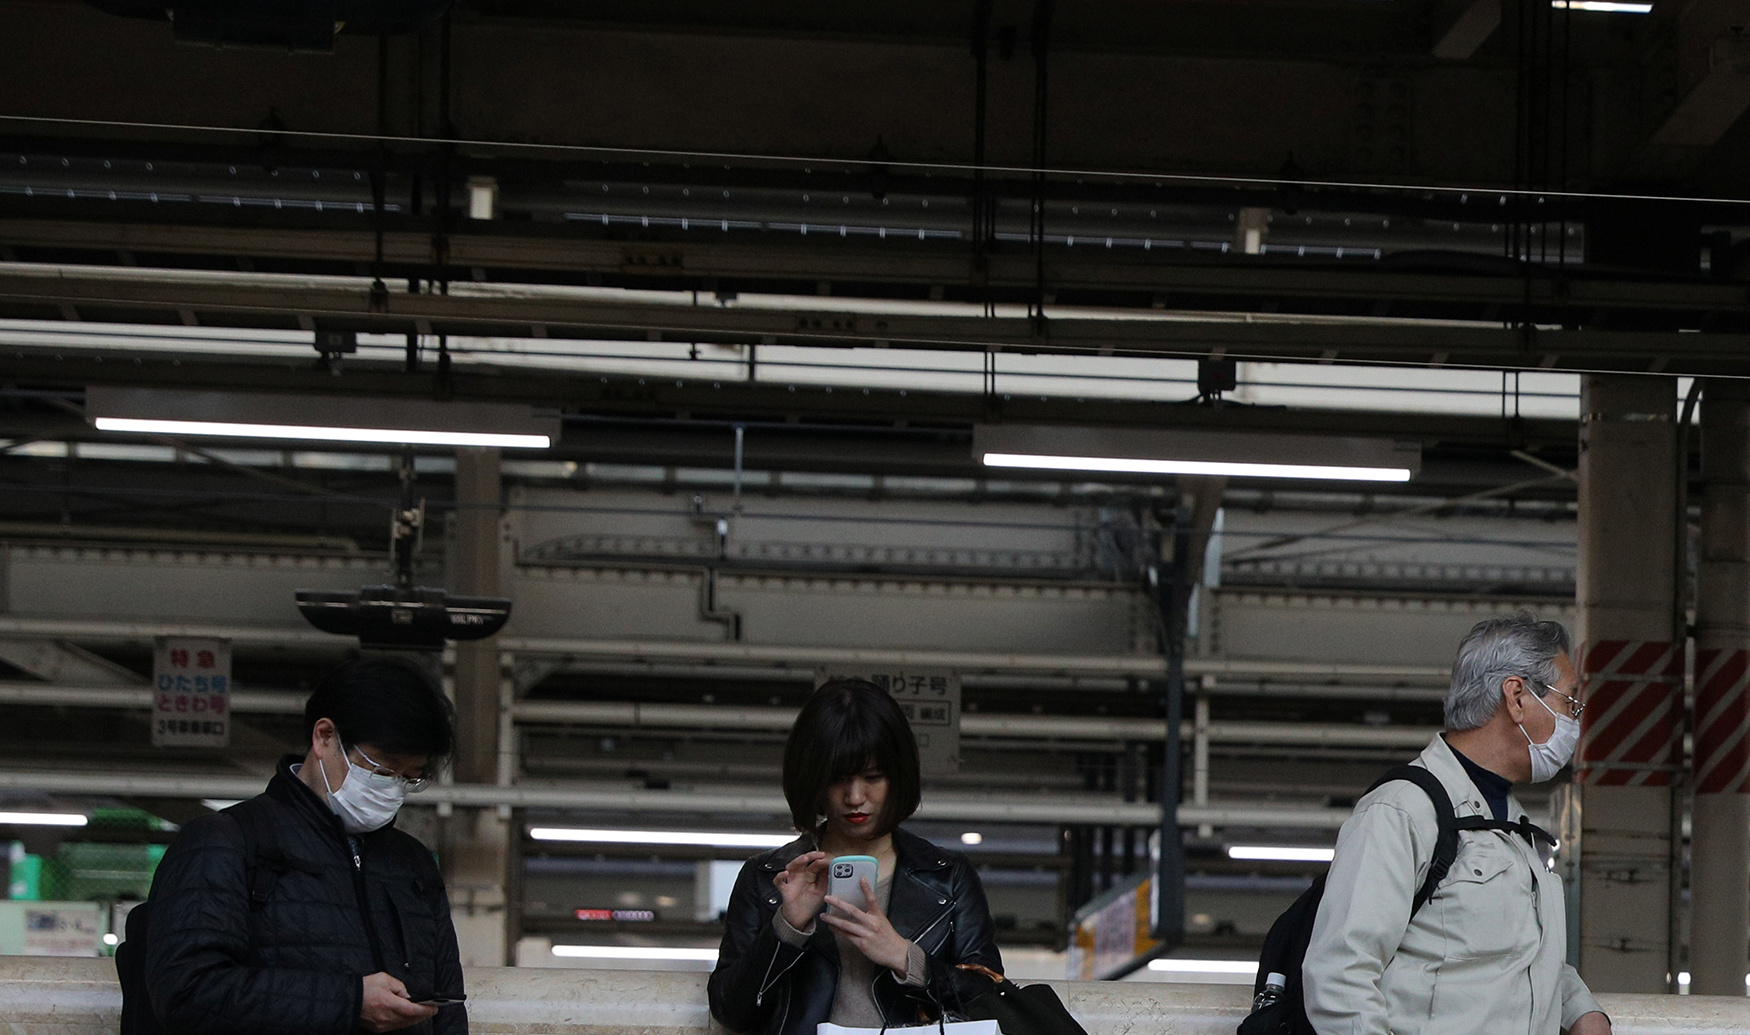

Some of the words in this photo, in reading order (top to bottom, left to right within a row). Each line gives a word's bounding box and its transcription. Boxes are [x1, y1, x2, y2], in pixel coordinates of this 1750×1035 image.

[158, 674, 227, 693] ひたち号
[157, 694, 226, 715] ときわ号
